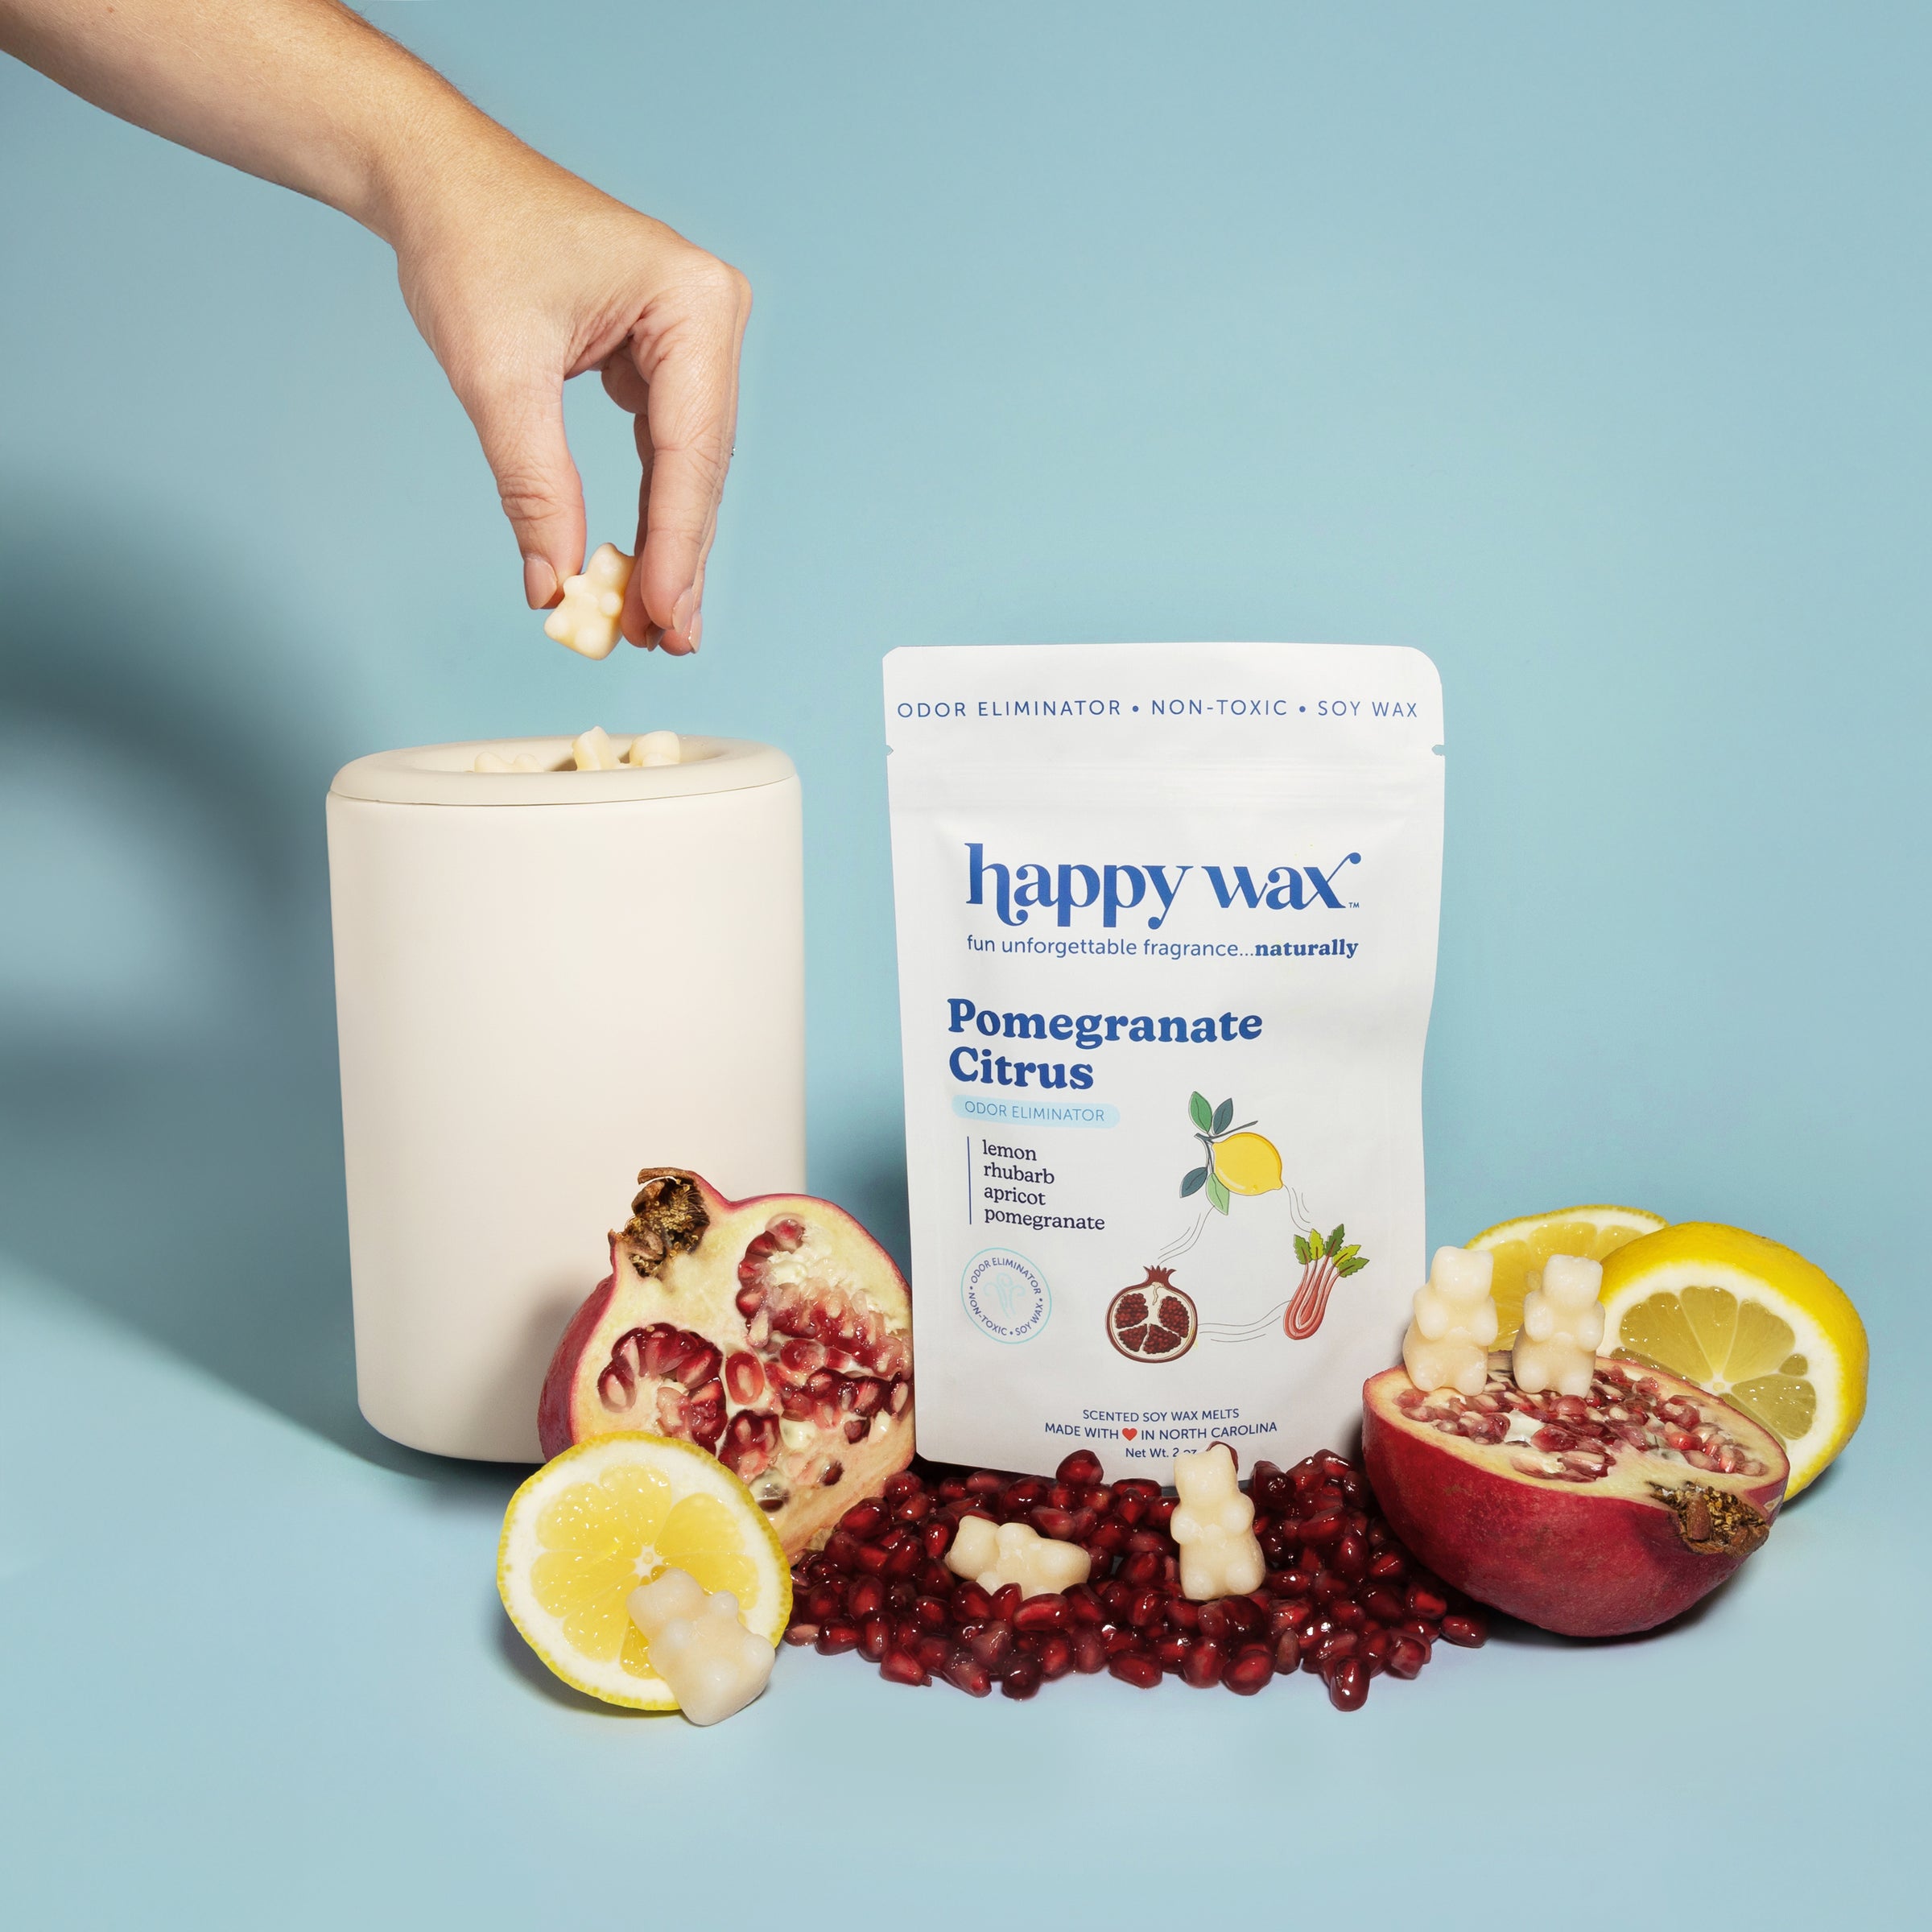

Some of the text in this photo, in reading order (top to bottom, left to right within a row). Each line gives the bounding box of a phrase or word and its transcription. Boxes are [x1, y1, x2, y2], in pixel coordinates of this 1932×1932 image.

[897, 699, 1418, 718] ODOR ELIMINATOR NON-TOXIC SOY WAX
[964, 843, 1194, 931] happy
[1200, 852, 1362, 910] wax
[967, 934, 995, 952] fun
[1001, 936, 1137, 959] unforgettable
[947, 998, 1262, 1050] Pomegranate
[949, 1046, 1094, 1089] Citrus
[964, 1100, 1104, 1121] ODOR ELIMINATOR
[981, 1138, 1038, 1162] lemon
[984, 1162, 1055, 1184] rhubarb
[984, 1186, 1046, 1206] apricot
[984, 1208, 1105, 1231] pomegranate
[968, 1257, 1043, 1336] ODOR ELIMINATOR NON-TOXIC SOY WAX
[1083, 1408, 1240, 1422] SCENTED SOY WAX MELTS
[1045, 1422, 1278, 1441] MADE WITH IN NORTH CAROLINA
[1125, 1447, 1146, 1458] Net
[1149, 1447, 1169, 1458] Wt.
[1172, 1447, 1179, 1458] 2
